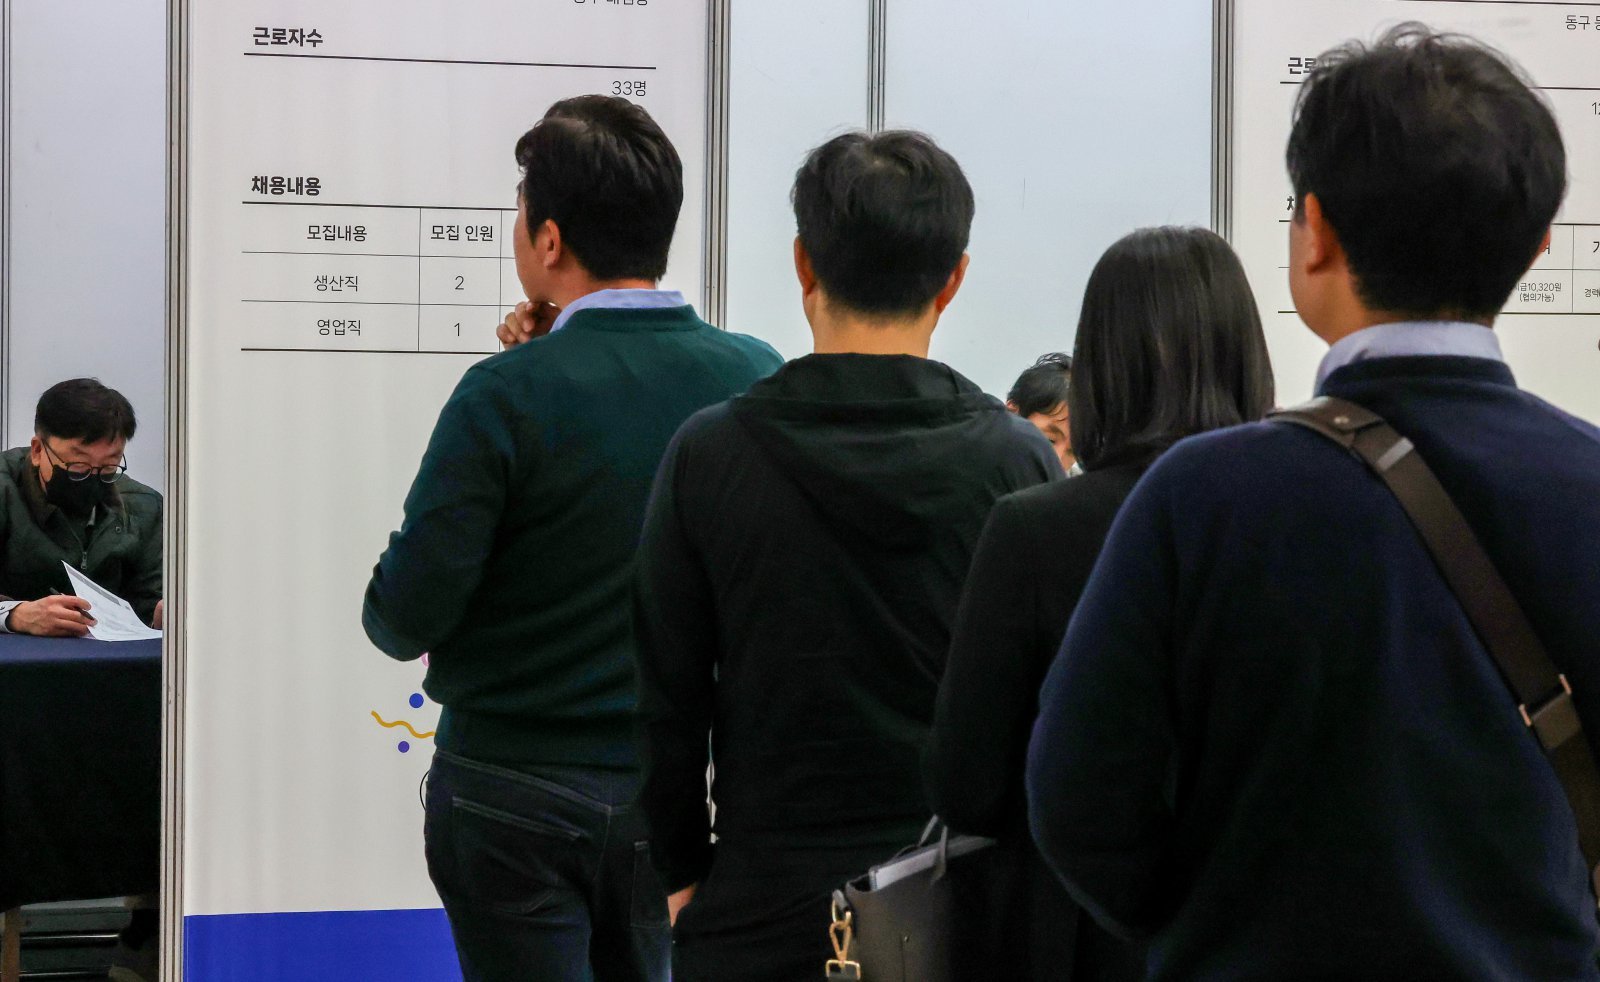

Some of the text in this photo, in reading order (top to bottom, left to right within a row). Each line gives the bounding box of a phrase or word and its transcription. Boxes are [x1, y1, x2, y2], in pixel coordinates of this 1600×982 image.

[1565, 14, 1590, 30] 동구
[252, 27, 324, 48] 근로자수
[1288, 57, 1316, 74] 근로
[612, 81, 647, 97] 33명
[251, 176, 322, 196] 채용내용
[307, 225, 368, 242] 모집내용
[430, 225, 494, 242] 모집 인원
[314, 275, 359, 292] 생산직
[455, 276, 464, 290] 2
[1519, 293, 1555, 302] (협의가능)
[1584, 288, 1600, 298] 경력
[316, 319, 361, 336] 영업직
[454, 323, 460, 337] 1
